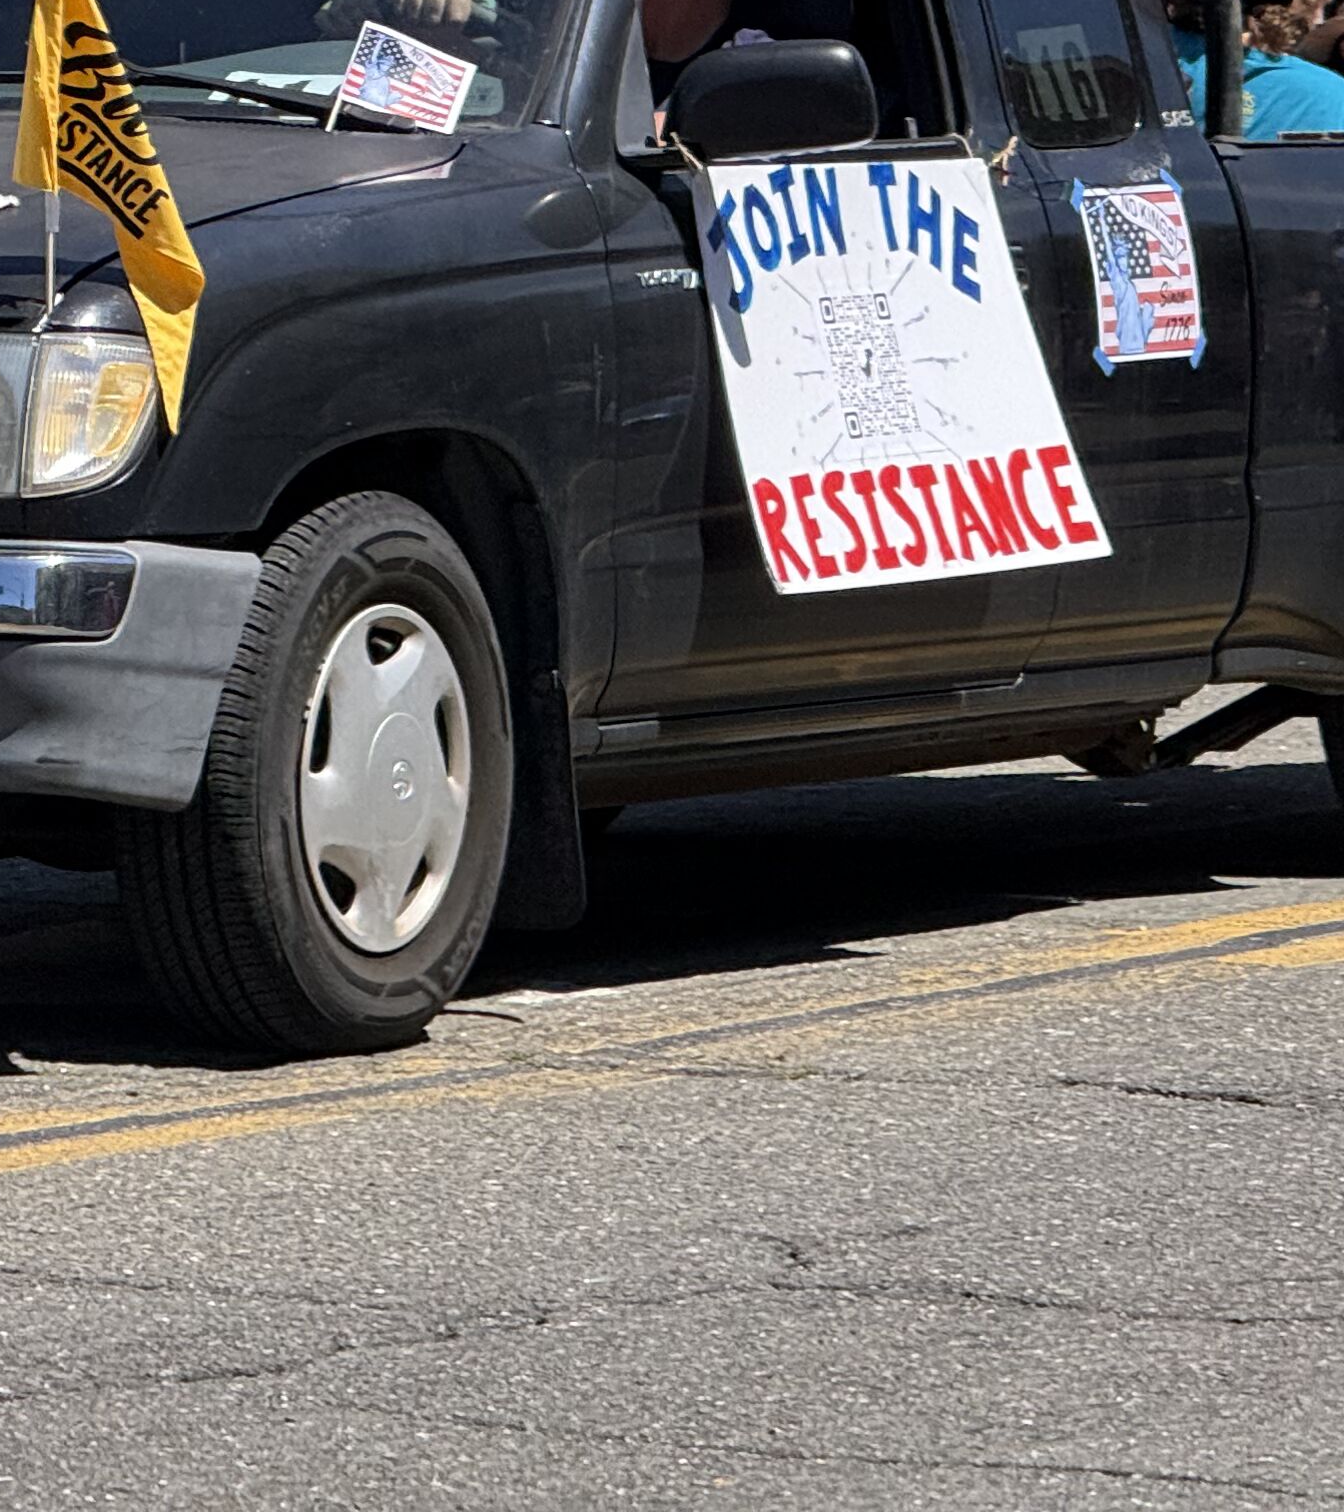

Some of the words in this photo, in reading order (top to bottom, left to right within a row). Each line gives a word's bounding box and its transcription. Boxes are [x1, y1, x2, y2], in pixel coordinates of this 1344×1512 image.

[707, 165, 847, 314] JOIN
[867, 163, 983, 303] THE
[1121, 195, 1140, 219] NO
[1139, 203, 1177, 246] KINGS
[1164, 316, 1192, 342] 1776
[753, 444, 1097, 584] RESISTANCE
